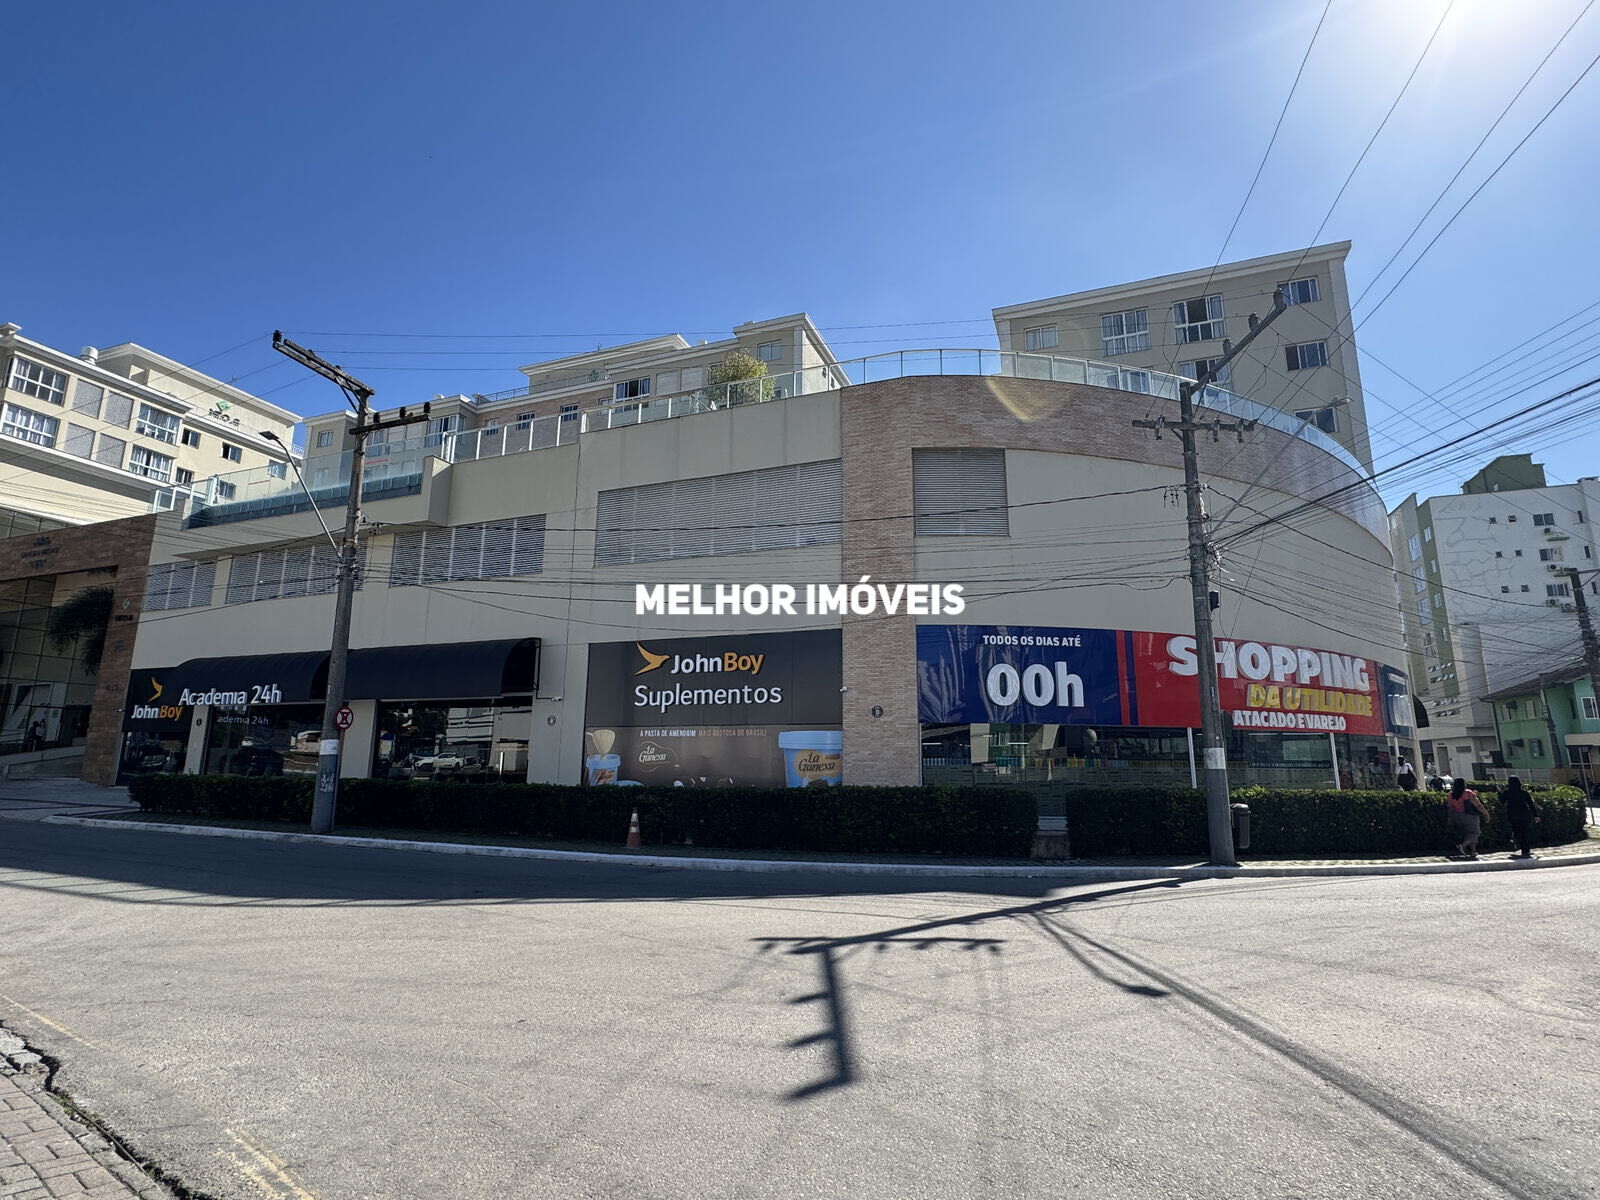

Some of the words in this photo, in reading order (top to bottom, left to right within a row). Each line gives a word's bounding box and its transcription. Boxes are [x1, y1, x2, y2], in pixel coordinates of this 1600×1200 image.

[983, 635, 1019, 645] TODOS
[1020, 636, 1034, 646] OS
[1036, 636, 1060, 646] DIAS
[1061, 635, 1082, 647] ATÉ
[1166, 636, 1370, 692] SHOPPING
[178, 687, 248, 706] Academia
[250, 683, 282, 704] 24h
[986, 661, 1085, 708] 00h
[634, 683, 783, 714] Suplementos
[1247, 683, 1281, 709] DA
[1283, 688, 1373, 717] UTILIDADE
[640, 729, 644, 737] A
[644, 729, 661, 737] PASTA
[661, 729, 668, 737] DE
[712, 729, 736, 737] GOSTOSA
[737, 729, 745, 737] DO
[1232, 710, 1296, 728] ATACADO
[1298, 713, 1305, 729] E
[1304, 714, 1347, 731] VAREJO
